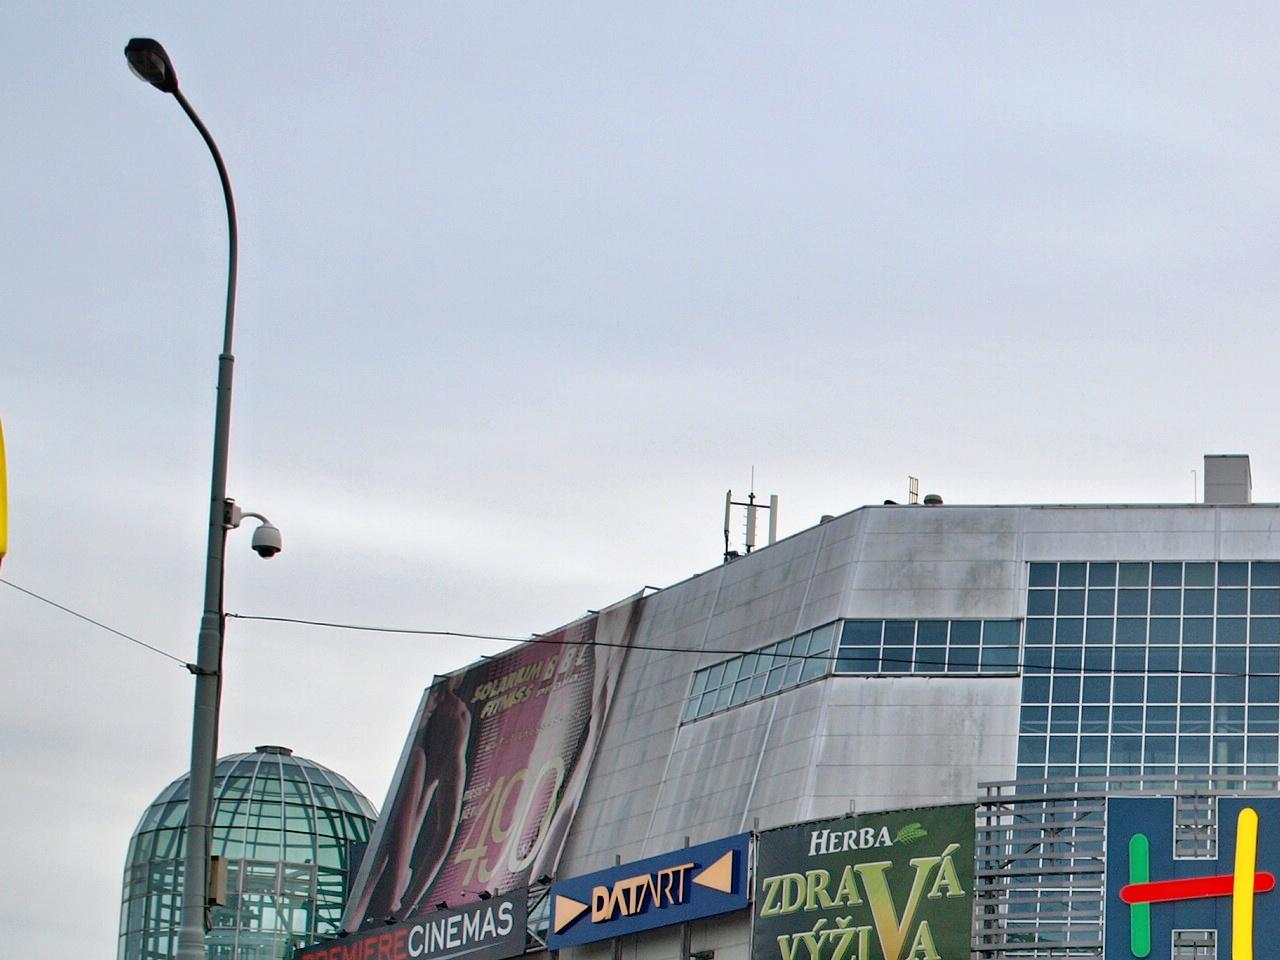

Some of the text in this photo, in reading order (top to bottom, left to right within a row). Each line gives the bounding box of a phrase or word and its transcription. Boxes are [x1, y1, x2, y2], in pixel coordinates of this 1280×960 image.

[808, 826, 893, 857] HERBA
[592, 863, 697, 924] DATART
[760, 843, 966, 945] ZDRAVÁ
[408, 902, 514, 958] CINEMAS
